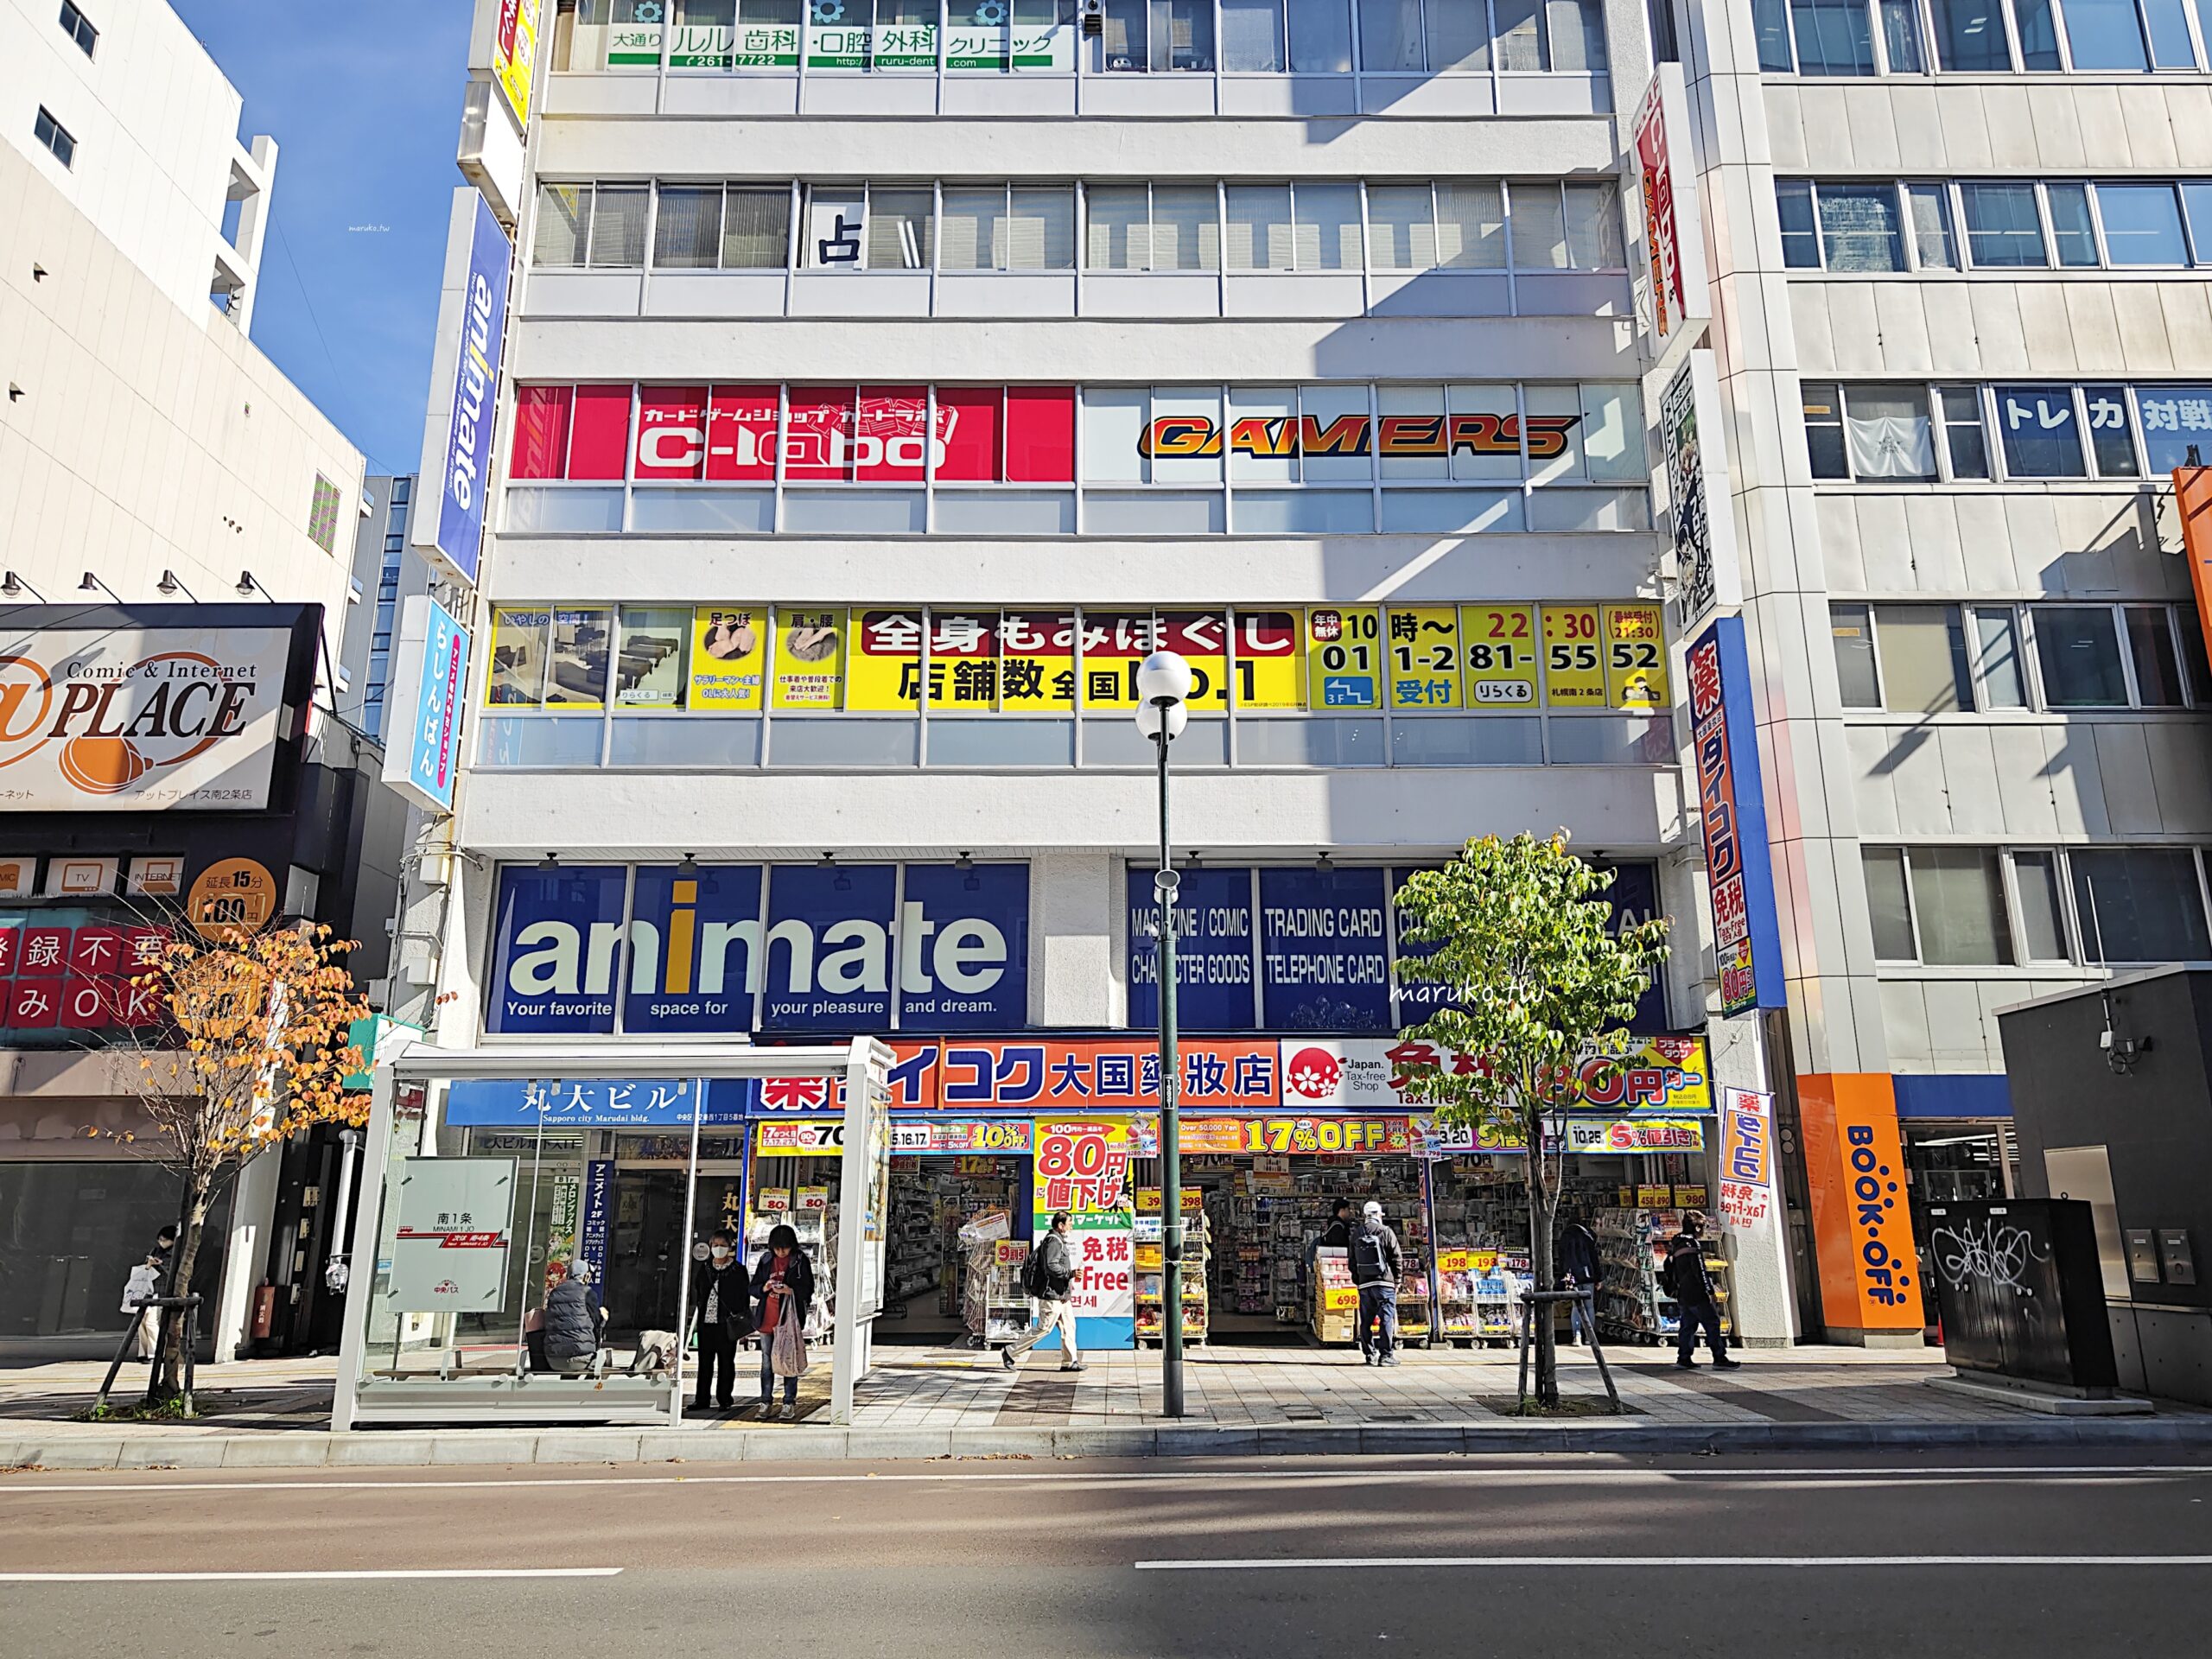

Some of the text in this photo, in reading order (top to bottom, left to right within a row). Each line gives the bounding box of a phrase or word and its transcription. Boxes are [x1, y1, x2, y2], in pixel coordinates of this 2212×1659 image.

[819, 213, 862, 264] 占
[1643, 168, 1669, 338] GAMERS
[454, 274, 494, 512] animate
[1138, 411, 1591, 460] GAMERS
[709, 612, 751, 626] 足つぼ
[1314, 614, 1338, 626] 年中
[867, 614, 1291, 652] 全身もみほぐし
[1314, 626, 1338, 638] 無休
[67, 661, 257, 679] Comic & Internet
[1327, 694, 1344, 703] 3F
[1395, 679, 1452, 704] 受付
[1479, 685, 1527, 699] りらくる
[1701, 728, 1734, 881] ダイコク
[76, 873, 90, 882] TV
[134, 872, 182, 882] INTERNET
[1132, 907, 1198, 938] MAGZINE
[1209, 907, 1249, 938] COMIC
[1265, 908, 1335, 938] TRADING
[1338, 908, 1382, 938] CARD
[508, 880, 1008, 995] animate
[1132, 954, 1250, 984] CHACTER GOODS
[1266, 954, 1344, 984] TELEPHONE
[1347, 954, 1385, 984] CARD
[507, 999, 997, 1019] Your favorite space for your pleasure and dream.
[1345, 1071, 1386, 1081] Tax-free
[1352, 1081, 1379, 1092] Shop
[518, 1084, 678, 1112] 丸大ビル
[543, 1115, 576, 1124] Sapporo
[577, 1115, 593, 1124] city
[594, 1115, 629, 1123] Marudai
[1038, 1135, 1127, 1176] 80円
[1046, 1178, 1122, 1210] 値下げ
[1147, 1197, 1161, 1206] 39
[1181, 1197, 1201, 1207] 398
[1685, 1194, 1705, 1205] 980
[437, 1212, 473, 1224] 南1条
[1082, 1236, 1128, 1262] 免税
[1446, 1257, 1466, 1268] 198
[1080, 1266, 1128, 1291] Free
[1337, 1295, 1357, 1306] 698
